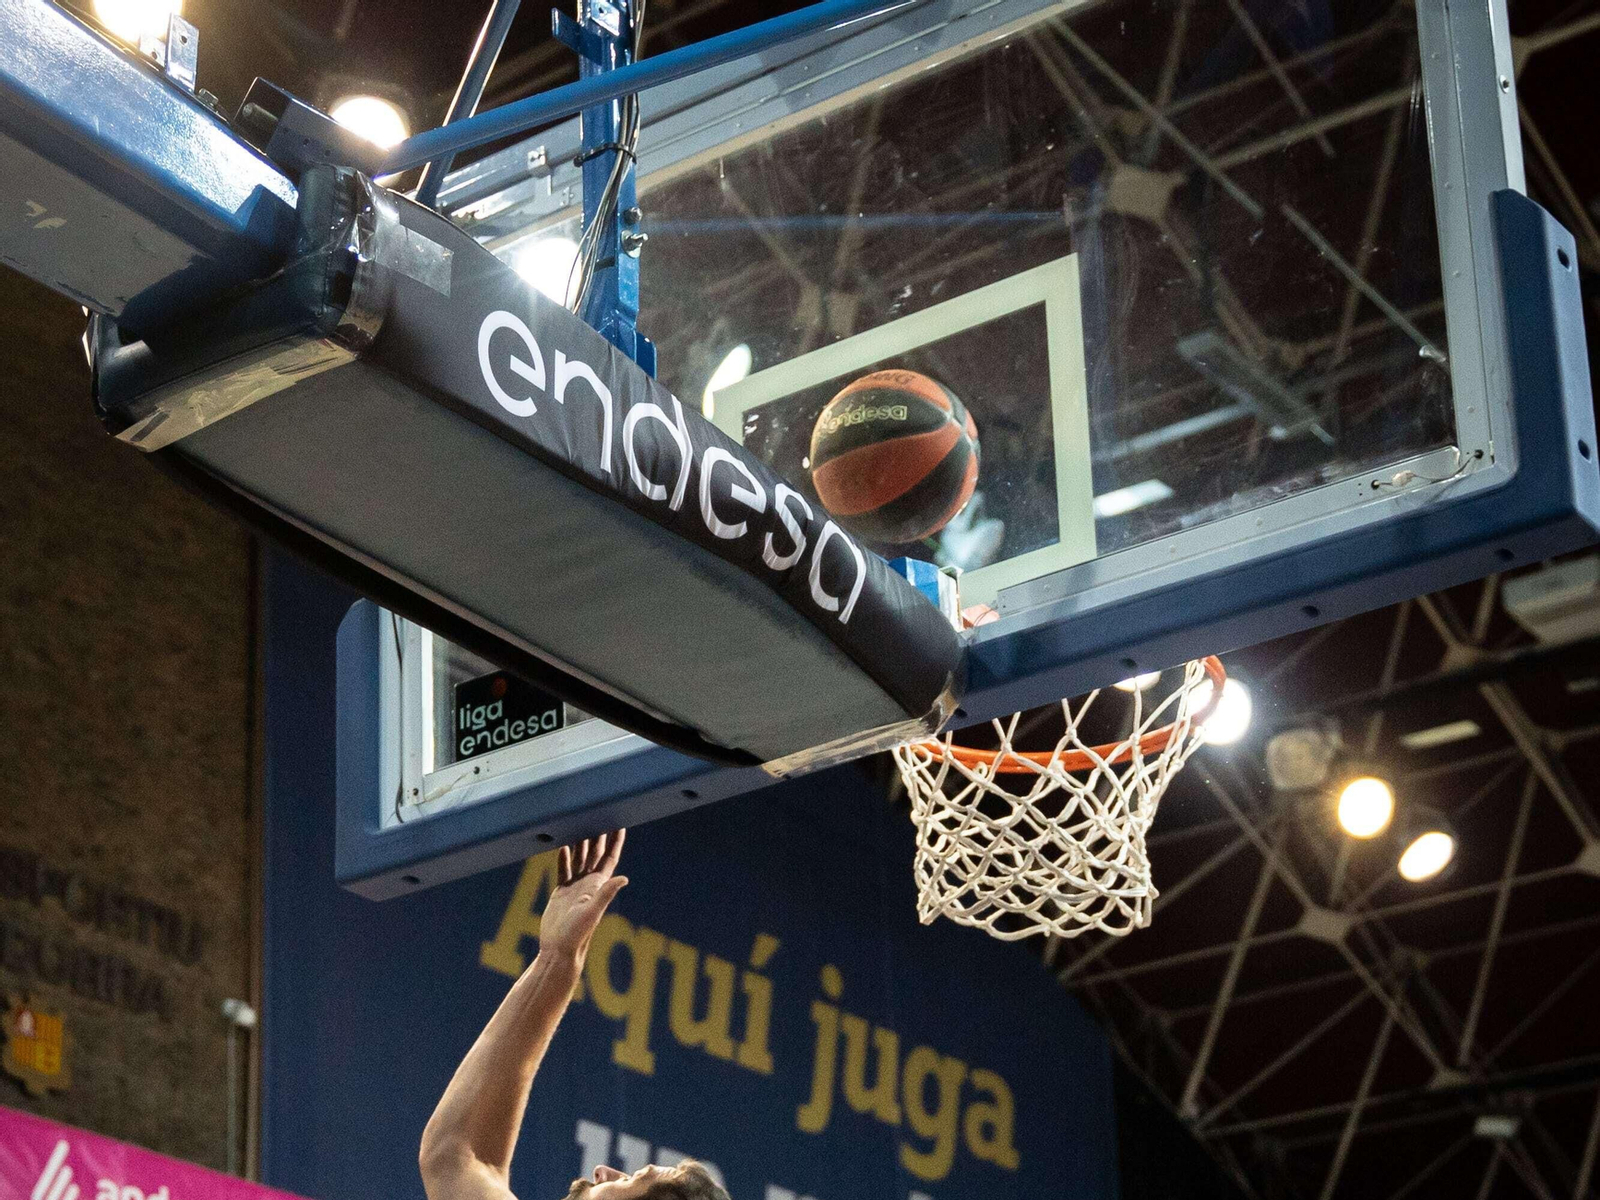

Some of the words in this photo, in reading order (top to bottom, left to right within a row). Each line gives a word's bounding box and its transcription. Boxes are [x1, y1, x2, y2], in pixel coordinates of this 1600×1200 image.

[478, 310, 867, 625] endesa
[460, 700, 503, 731] liga
[460, 709, 557, 755] endesa
[796, 963, 1021, 1181] juga
